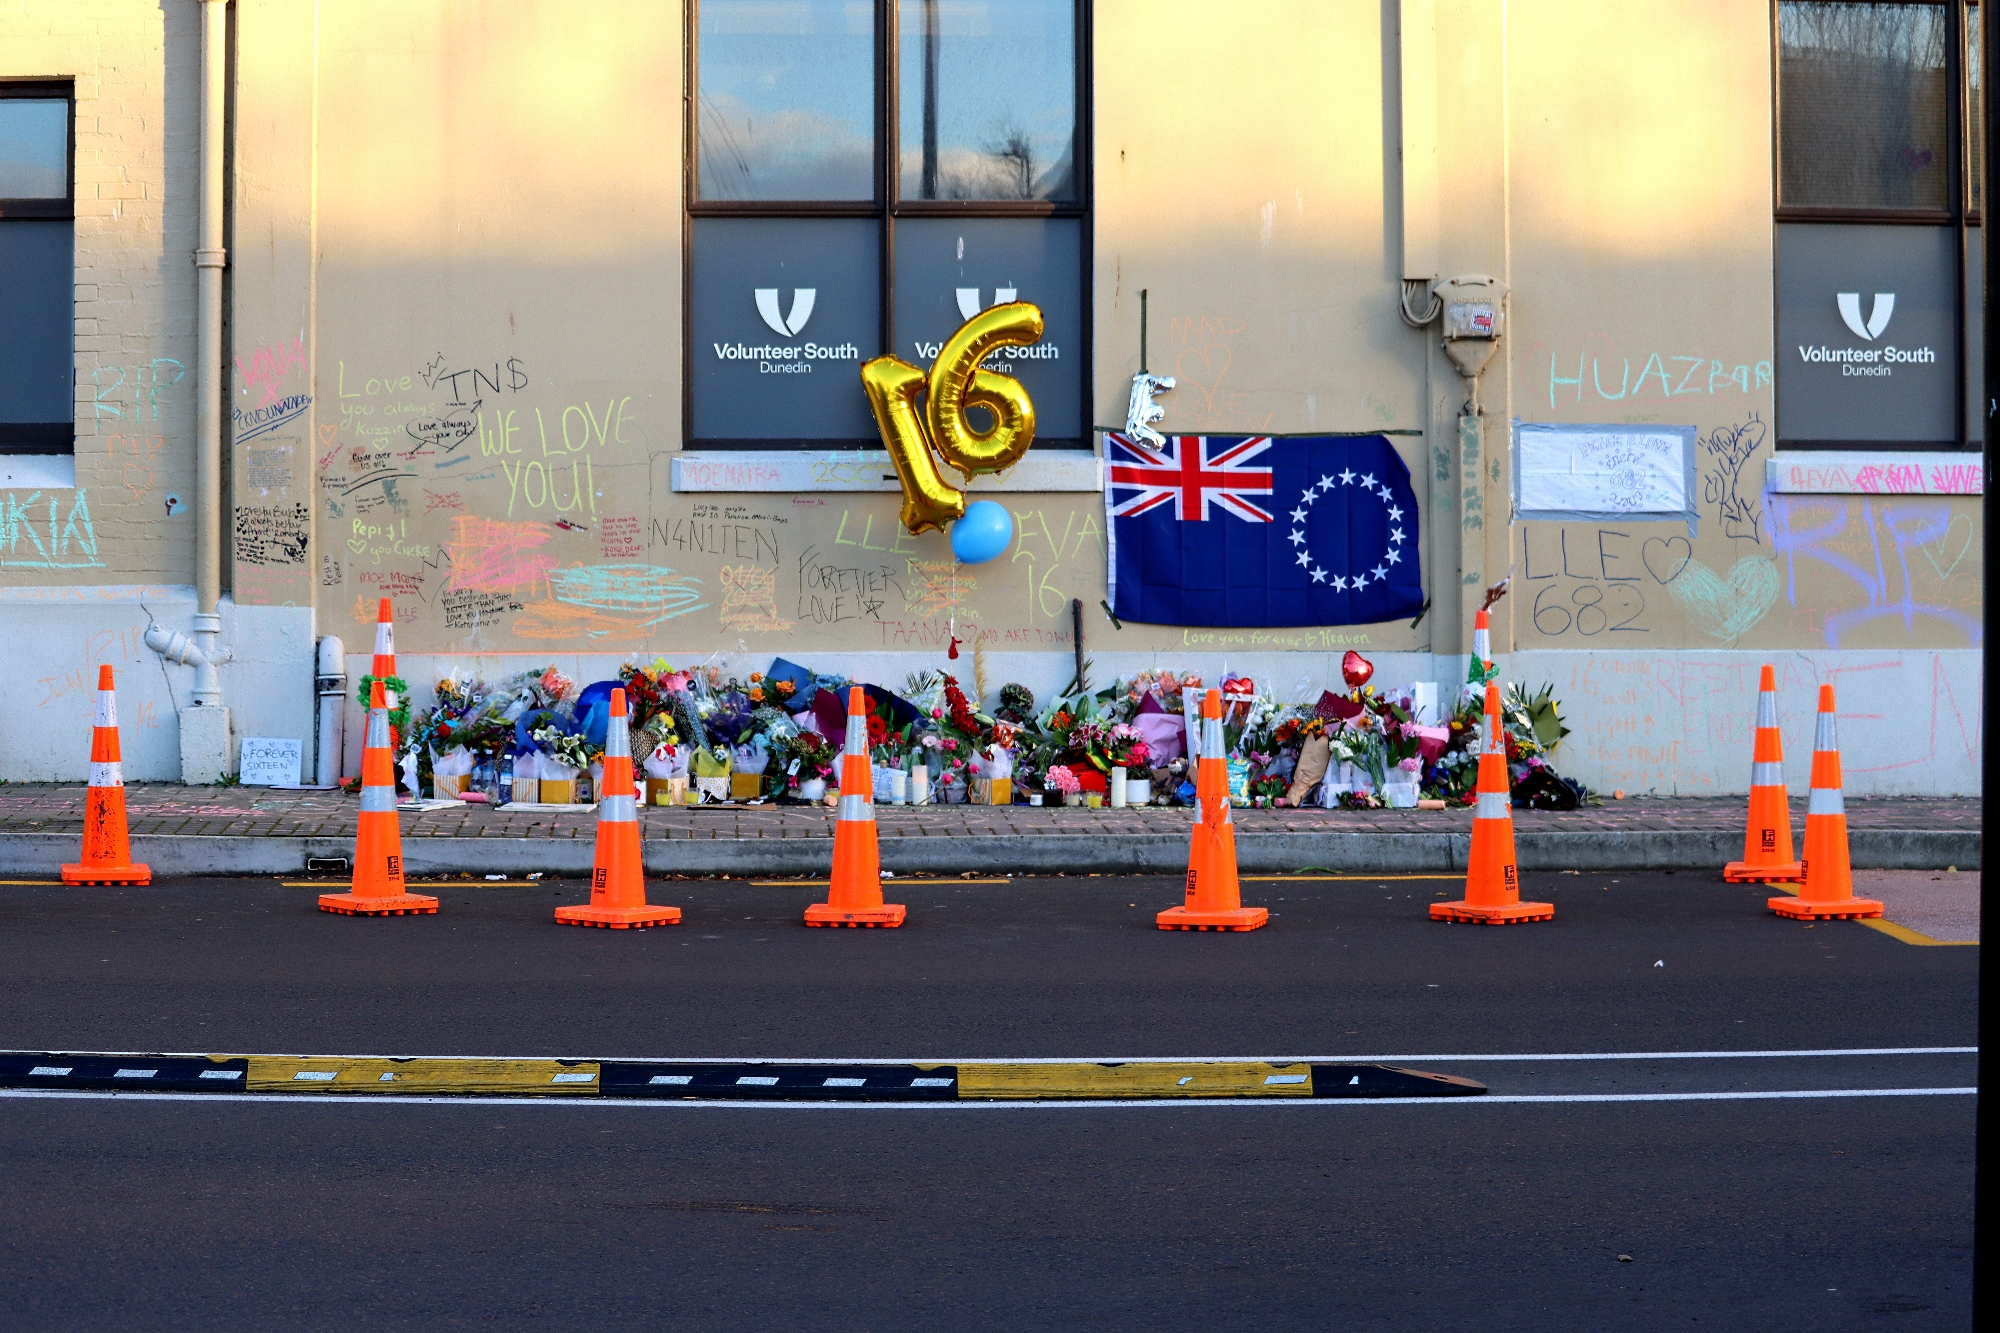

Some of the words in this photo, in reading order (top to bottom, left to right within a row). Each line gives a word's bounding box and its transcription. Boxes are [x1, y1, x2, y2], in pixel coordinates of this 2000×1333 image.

[713, 342, 802, 360] Volunteer
[803, 342, 859, 360] South
[1005, 343, 1059, 360] South
[1798, 346, 1881, 363] Volunteer
[1883, 346, 1936, 363] South
[760, 361, 811, 374] Dunedin
[1842, 364, 1891, 377] Dunedin
[339, 360, 412, 398] Love
[91, 357, 186, 430] RIP
[339, 402, 375, 431] you
[478, 409, 522, 457] WE
[535, 396, 637, 457] LOVE
[1637, 434, 1673, 456] LOVE
[1609, 469, 1646, 490] 682
[1012, 510, 1107, 563] EVA
[370, 546, 392, 565] you
[1028, 562, 1068, 624] 16
[1533, 583, 1650, 637] 682
[1183, 629, 1215, 646] Love
[1219, 631, 1245, 647] you
[1319, 629, 1372, 647] Heaven
[249, 748, 299, 760] FOREVER
[246, 761, 289, 771] SIXTEEN
